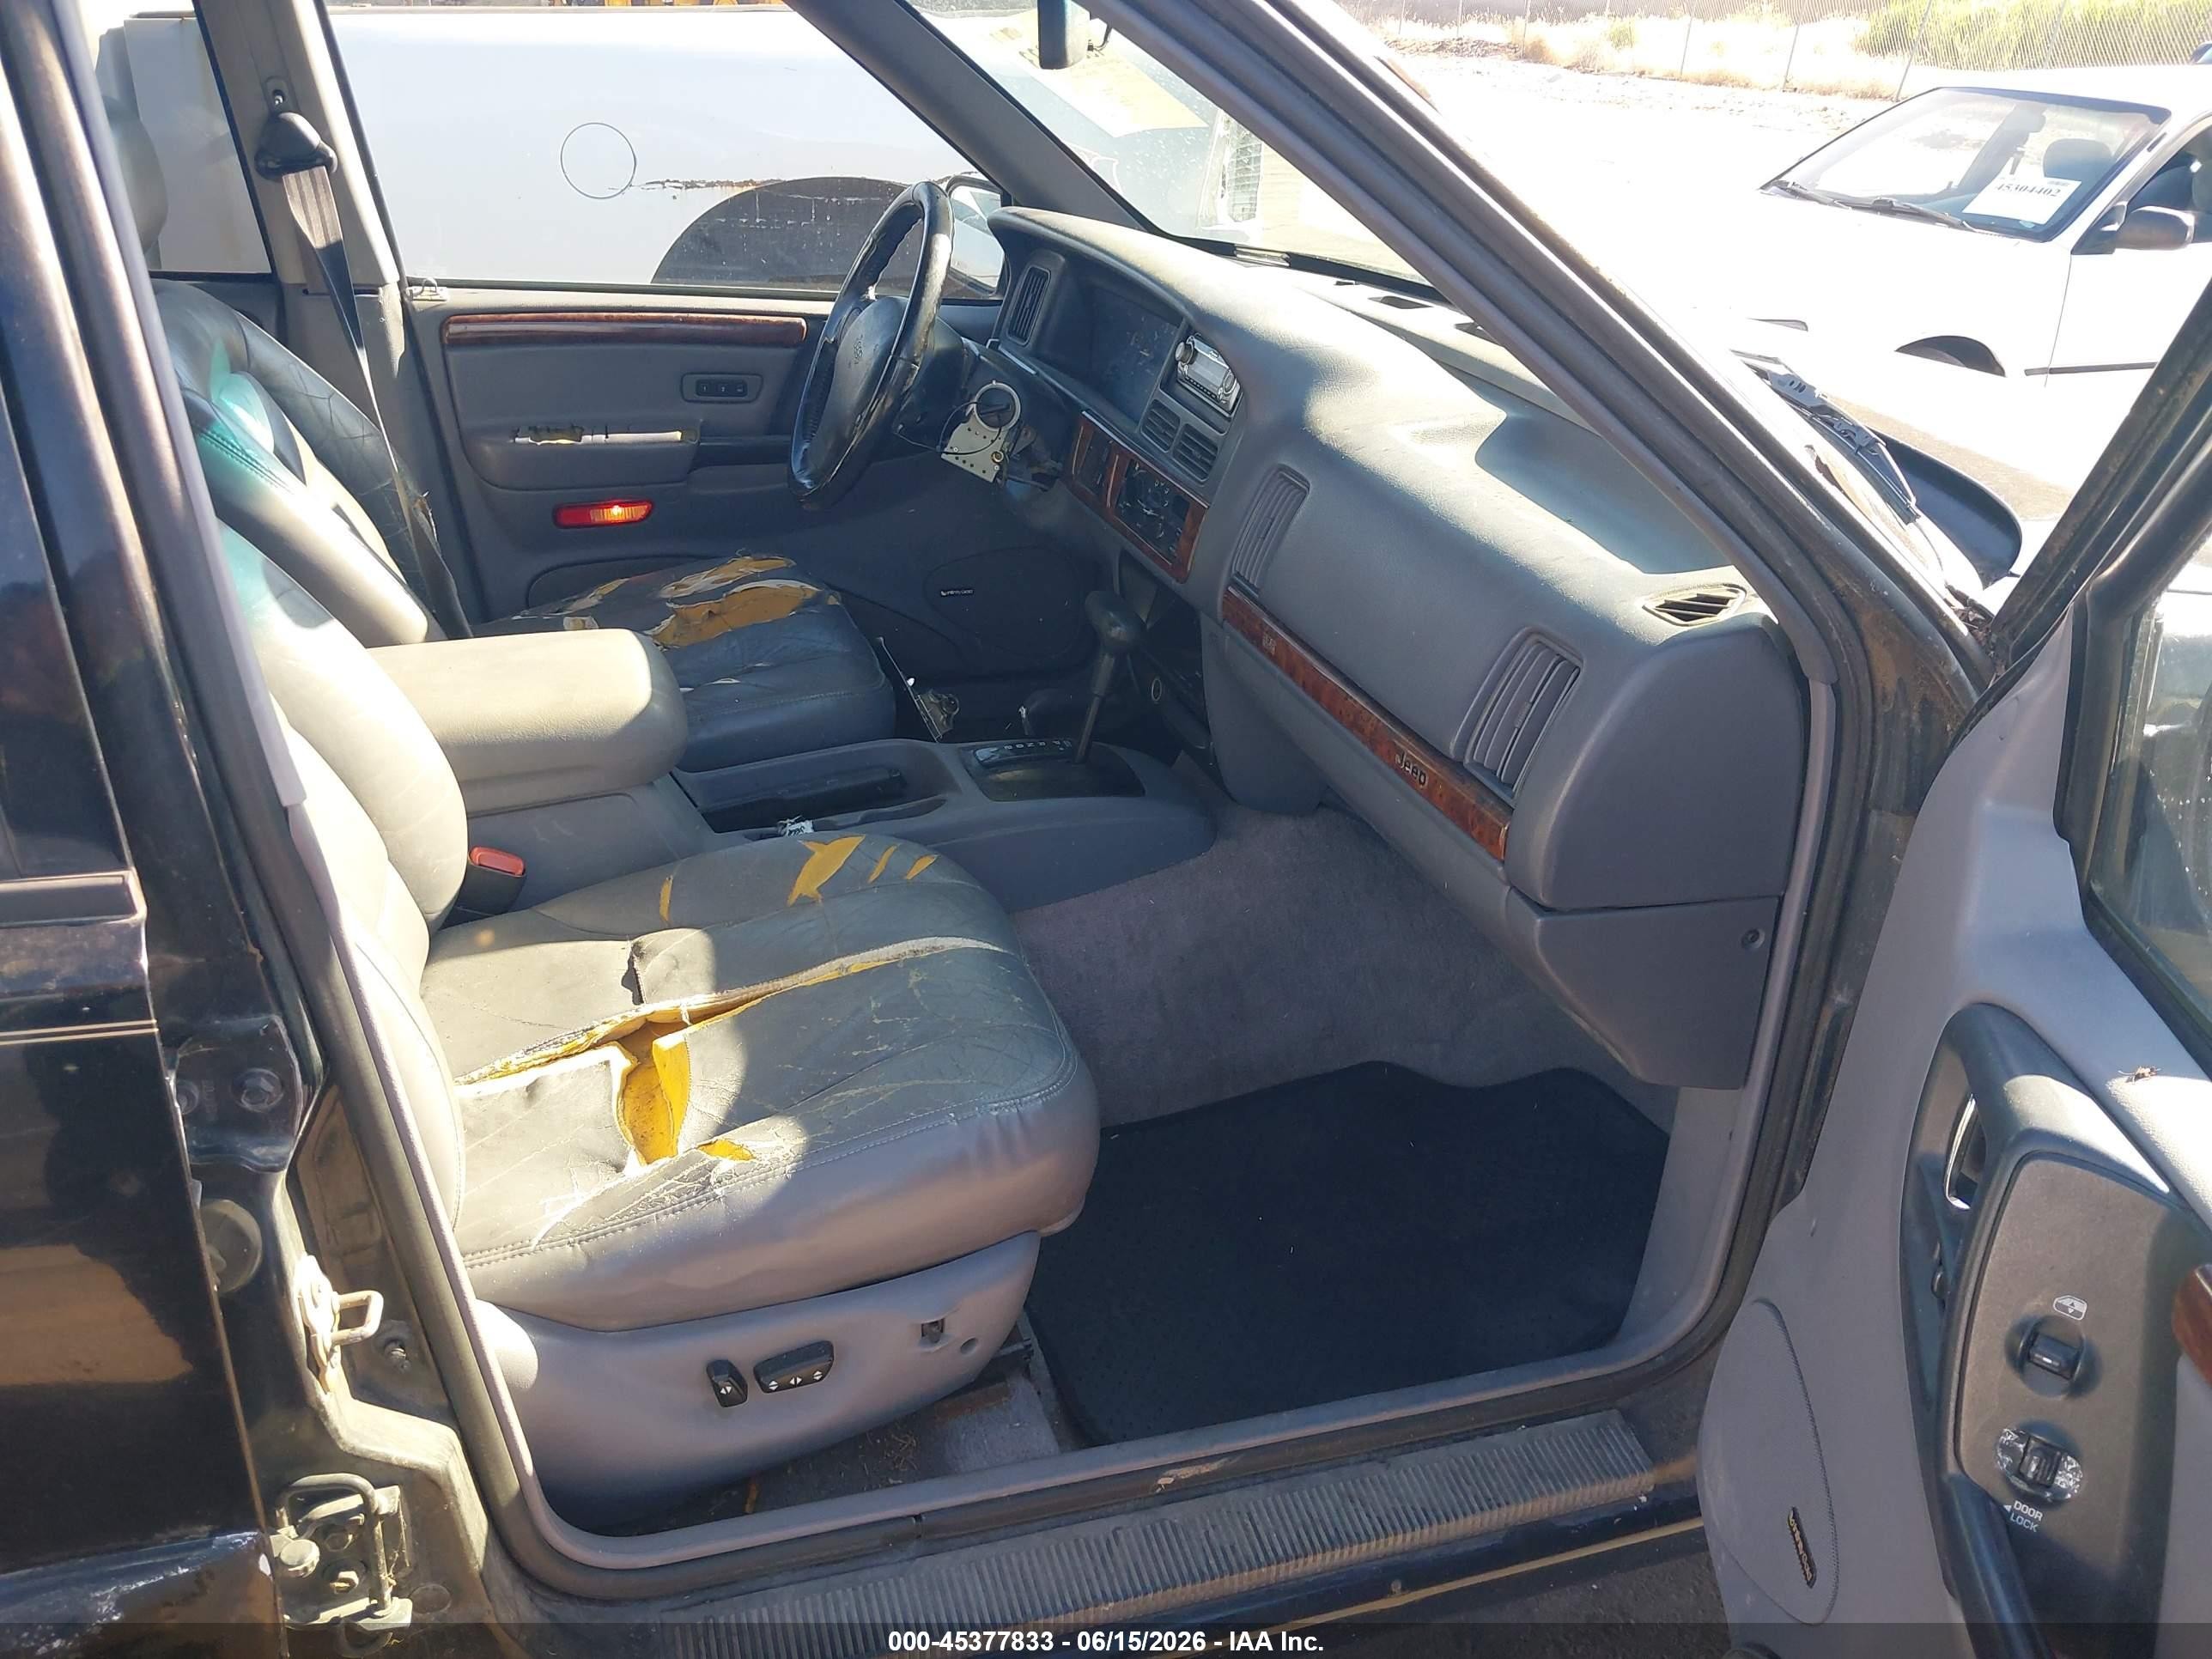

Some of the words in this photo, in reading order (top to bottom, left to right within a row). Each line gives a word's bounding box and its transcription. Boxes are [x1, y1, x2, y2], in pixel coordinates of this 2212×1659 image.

[1395, 751, 1428, 788] Jeep
[2014, 1500, 2044, 1521] DOOR
[2010, 1513, 2039, 1532] LOCK
